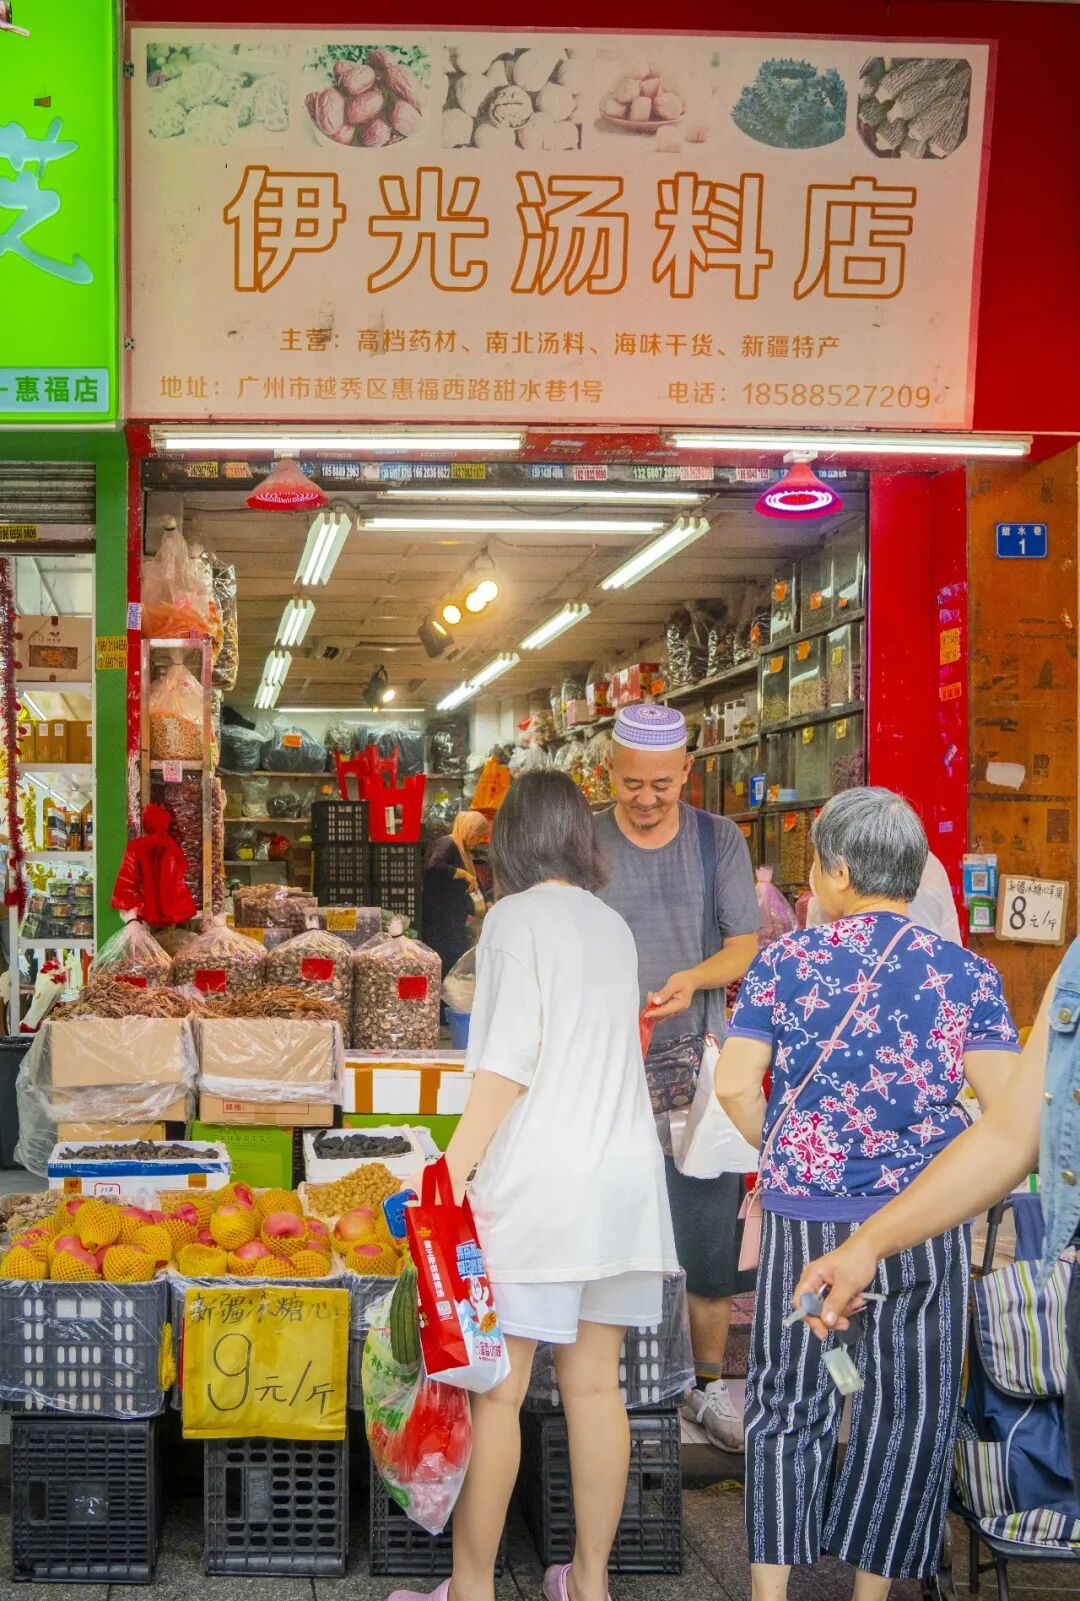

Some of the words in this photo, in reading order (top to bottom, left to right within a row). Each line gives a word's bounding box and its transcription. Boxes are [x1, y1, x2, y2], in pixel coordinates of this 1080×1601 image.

[223, 165, 917, 300] 伊光汤料店
[1019, 538, 1025, 554] 1
[1009, 895, 1057, 932] 8元/斤
[207, 1333, 336, 1415] 9元/斤
